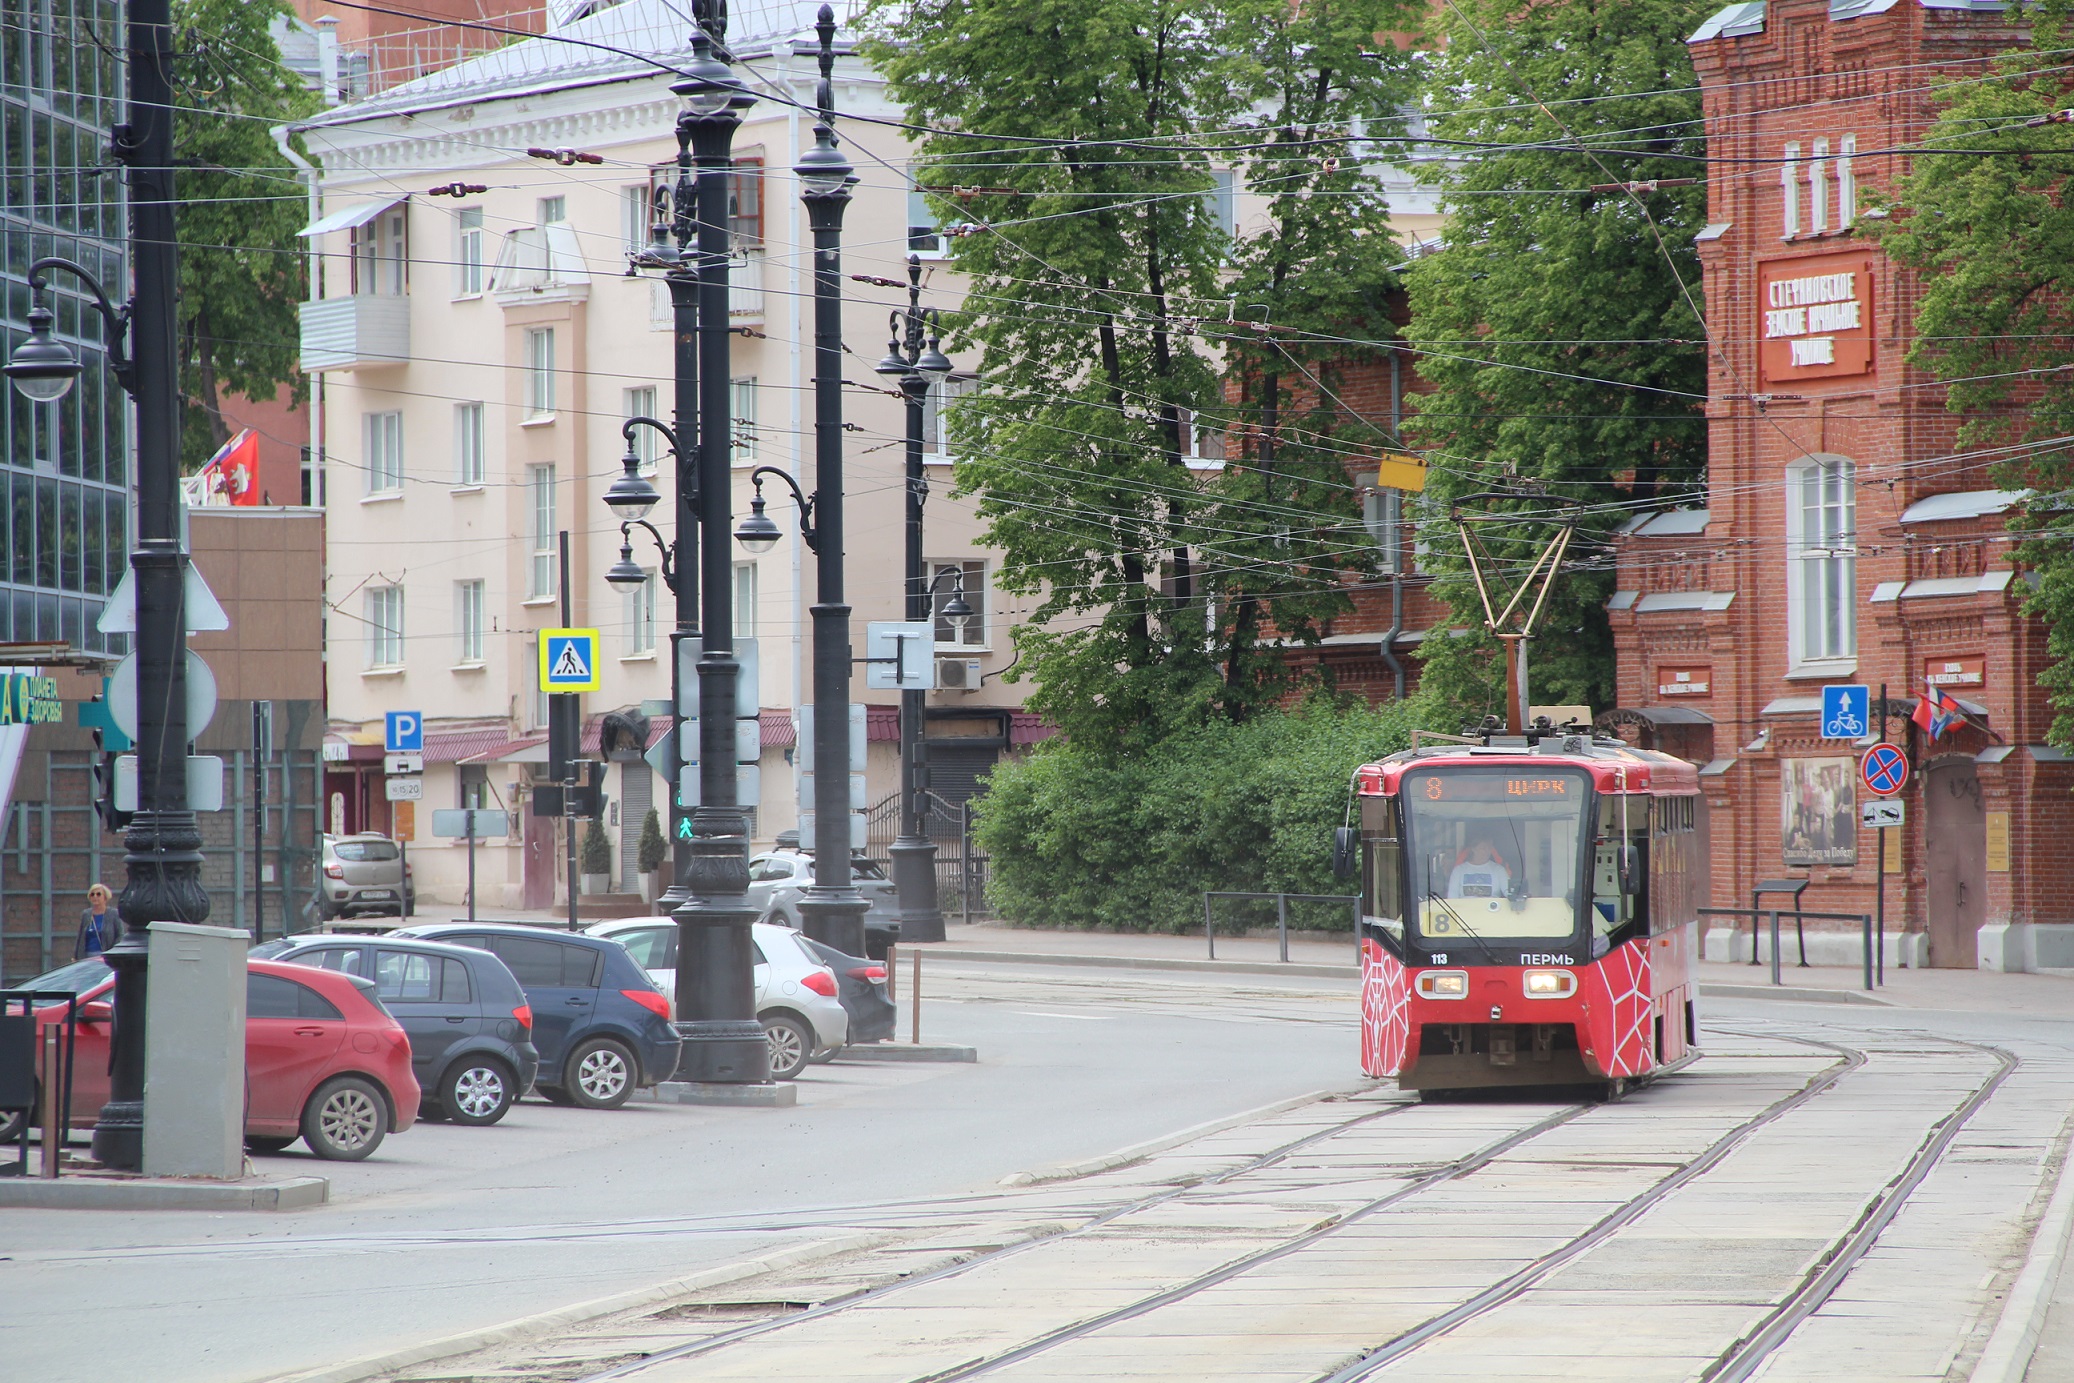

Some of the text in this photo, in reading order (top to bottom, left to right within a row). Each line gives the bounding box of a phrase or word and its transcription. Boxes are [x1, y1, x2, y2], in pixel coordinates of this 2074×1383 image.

[30, 676, 58, 698] ПЛАНЕТА
[30, 699, 62, 724] ЗДОРОВЬЯ
[395, 714, 416, 747] P
[408, 784, 419, 794] 20
[1426, 777, 1443, 800] 8
[1507, 780, 1565, 795] ЦИРК
[1434, 913, 1450, 933] 8
[1431, 953, 1448, 965] 113
[1520, 953, 1575, 965] ПЕРМЬ
